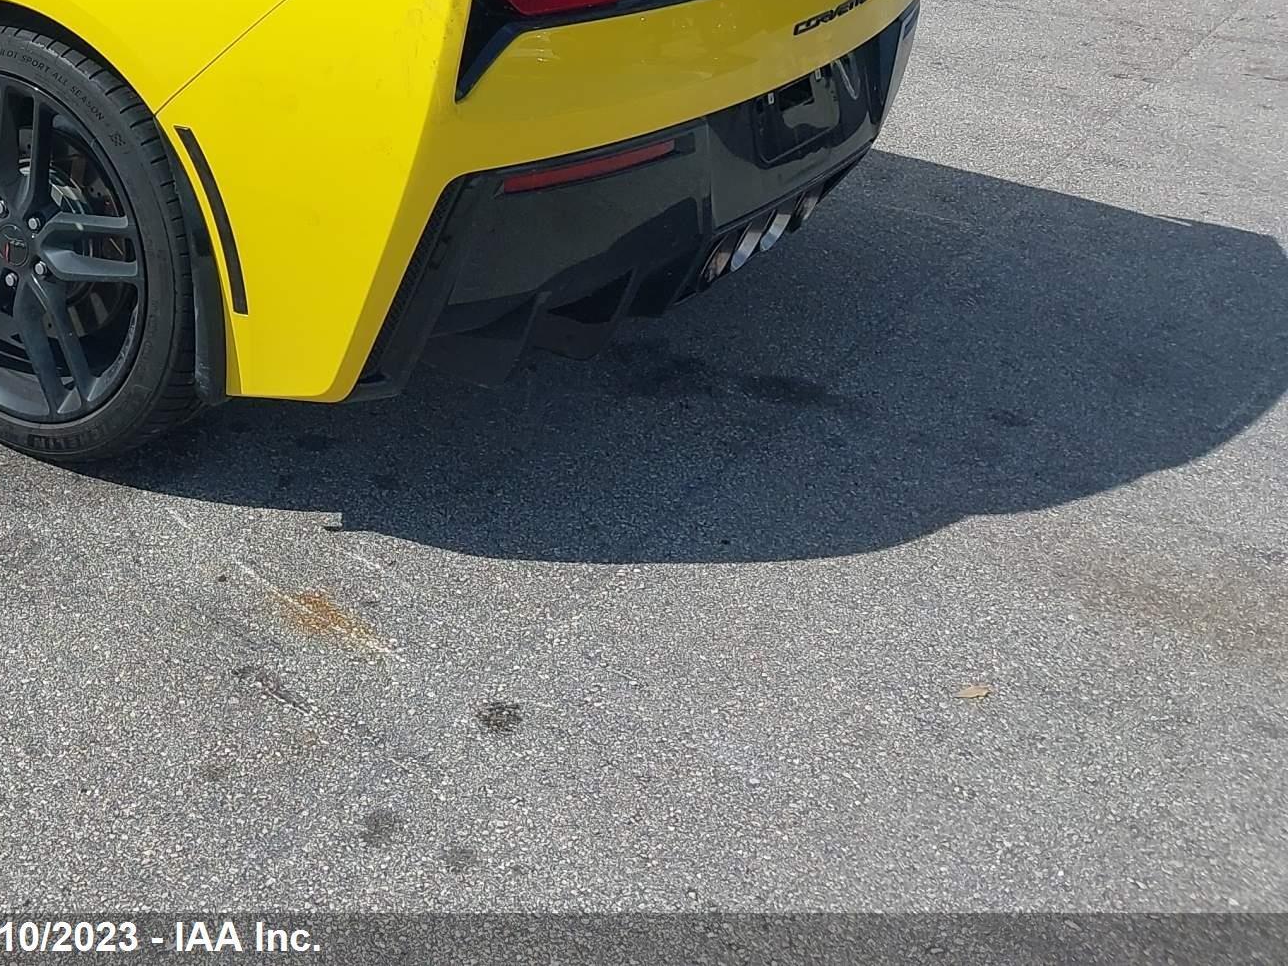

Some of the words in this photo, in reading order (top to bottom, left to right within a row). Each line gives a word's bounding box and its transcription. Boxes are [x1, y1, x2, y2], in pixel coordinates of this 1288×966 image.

[21, 54, 51, 74] SPORT
[52, 71, 68, 86] ALL
[70, 85, 105, 121] SEASON
